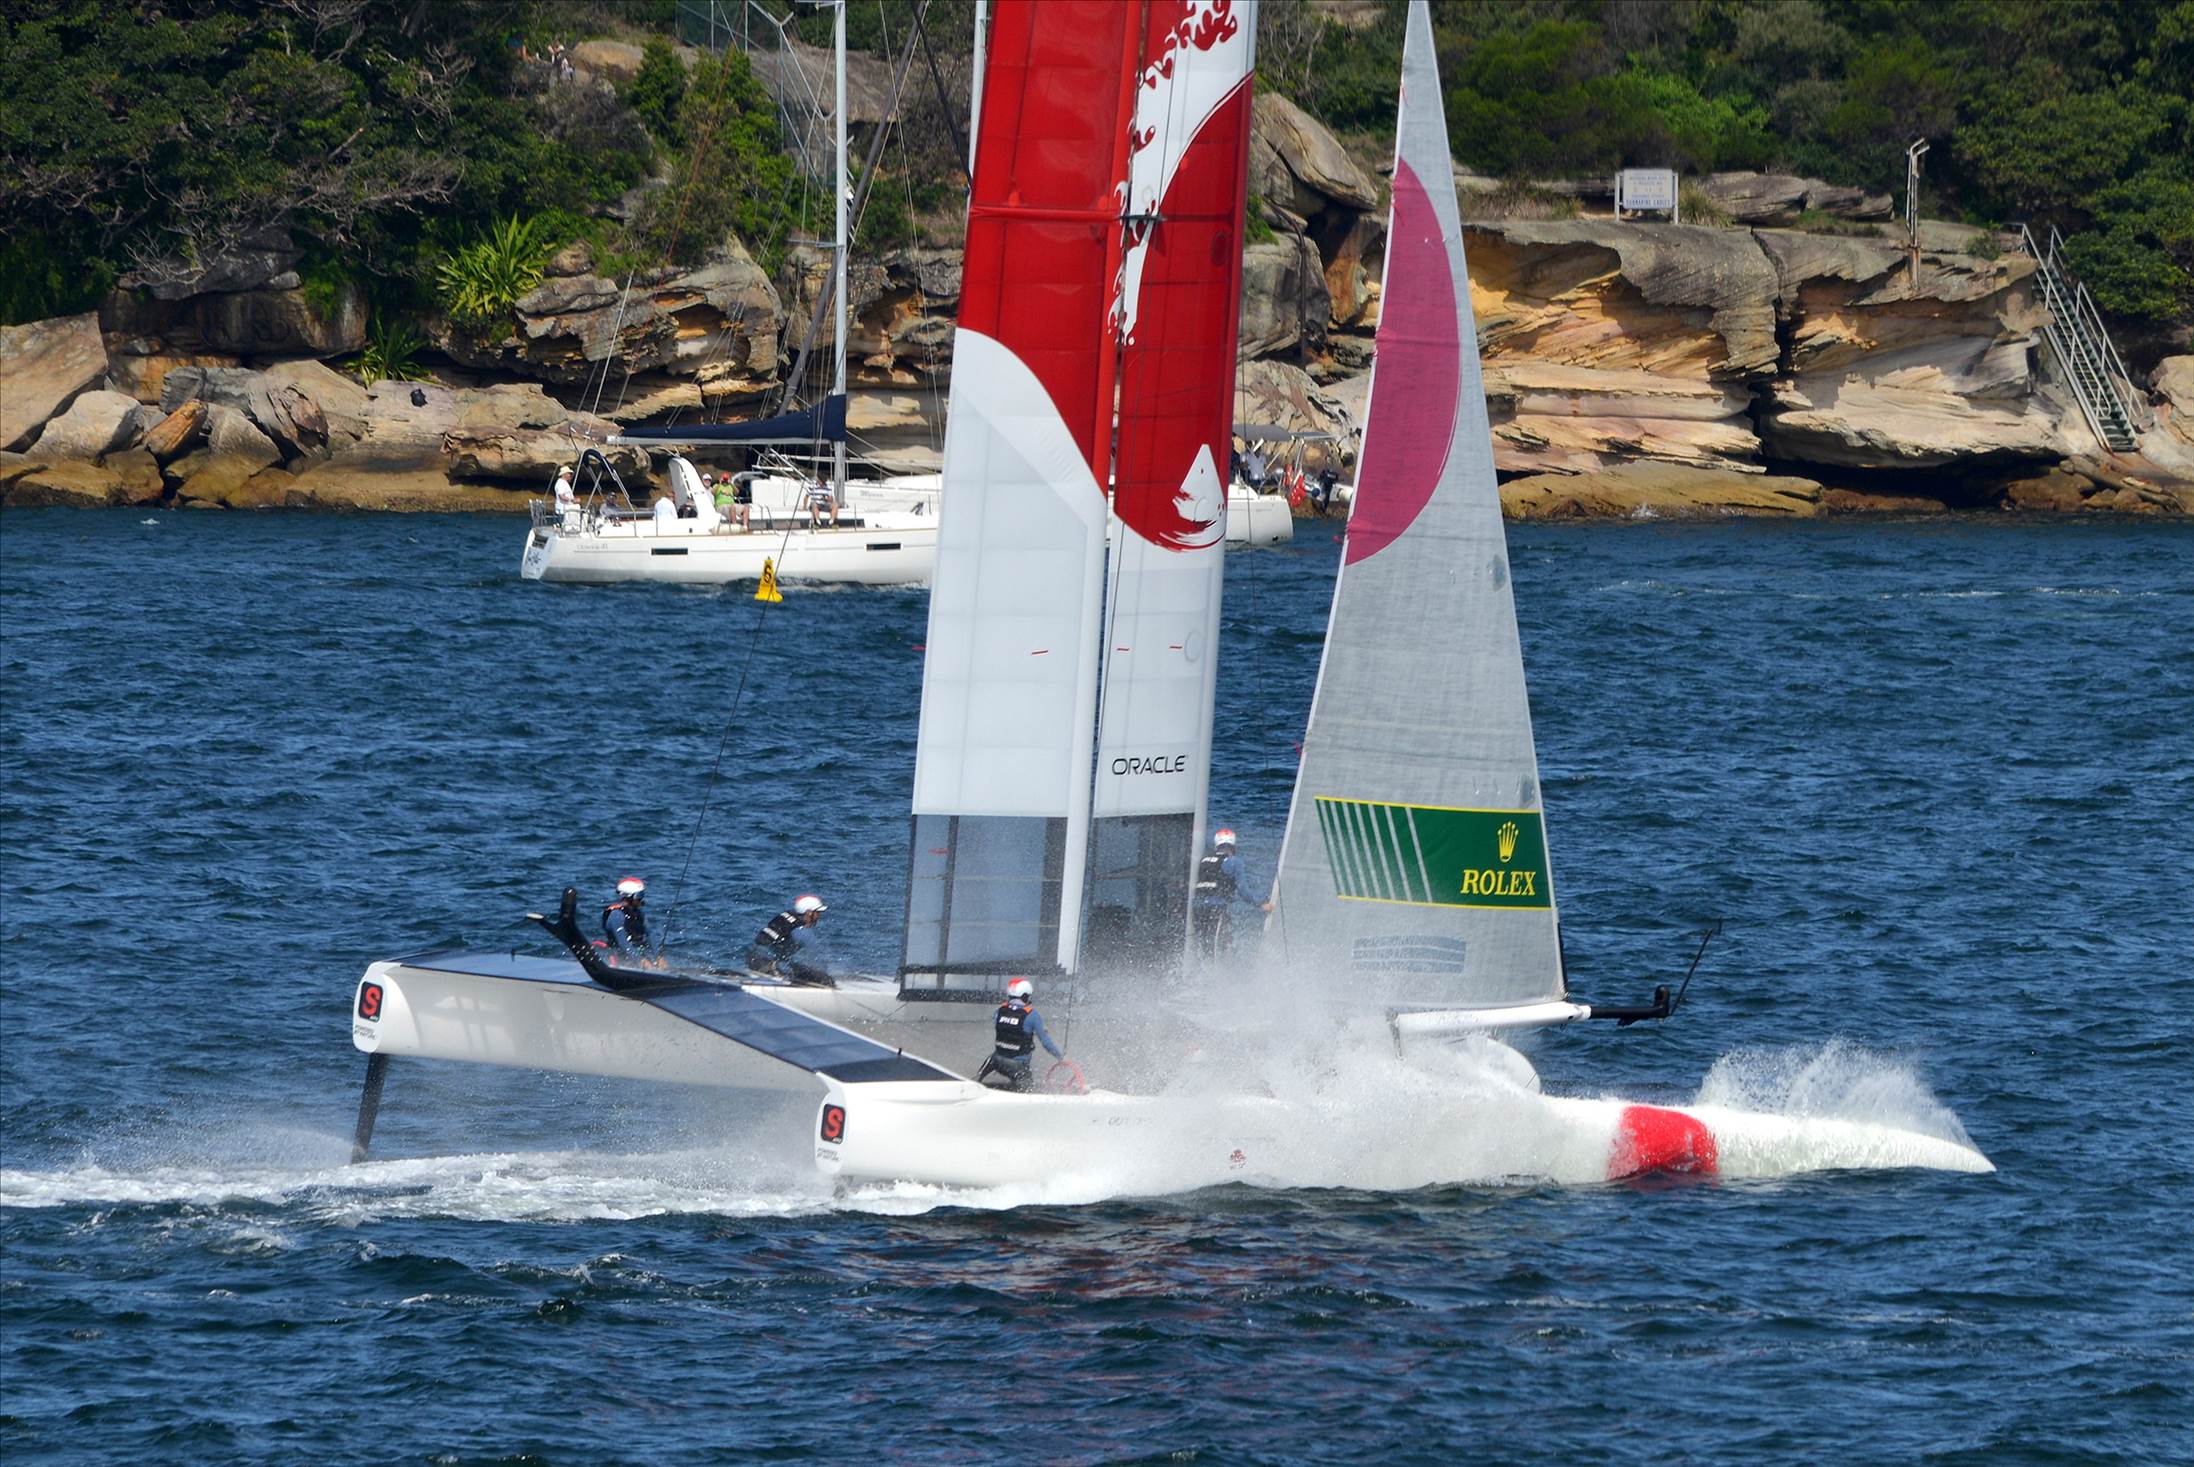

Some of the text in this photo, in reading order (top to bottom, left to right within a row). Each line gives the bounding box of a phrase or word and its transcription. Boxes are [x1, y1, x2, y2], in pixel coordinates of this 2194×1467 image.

[1111, 755, 1186, 775] ORACLE
[1460, 869, 1536, 896] ROLEX
[362, 986, 381, 1016] S
[825, 1107, 844, 1137] S
